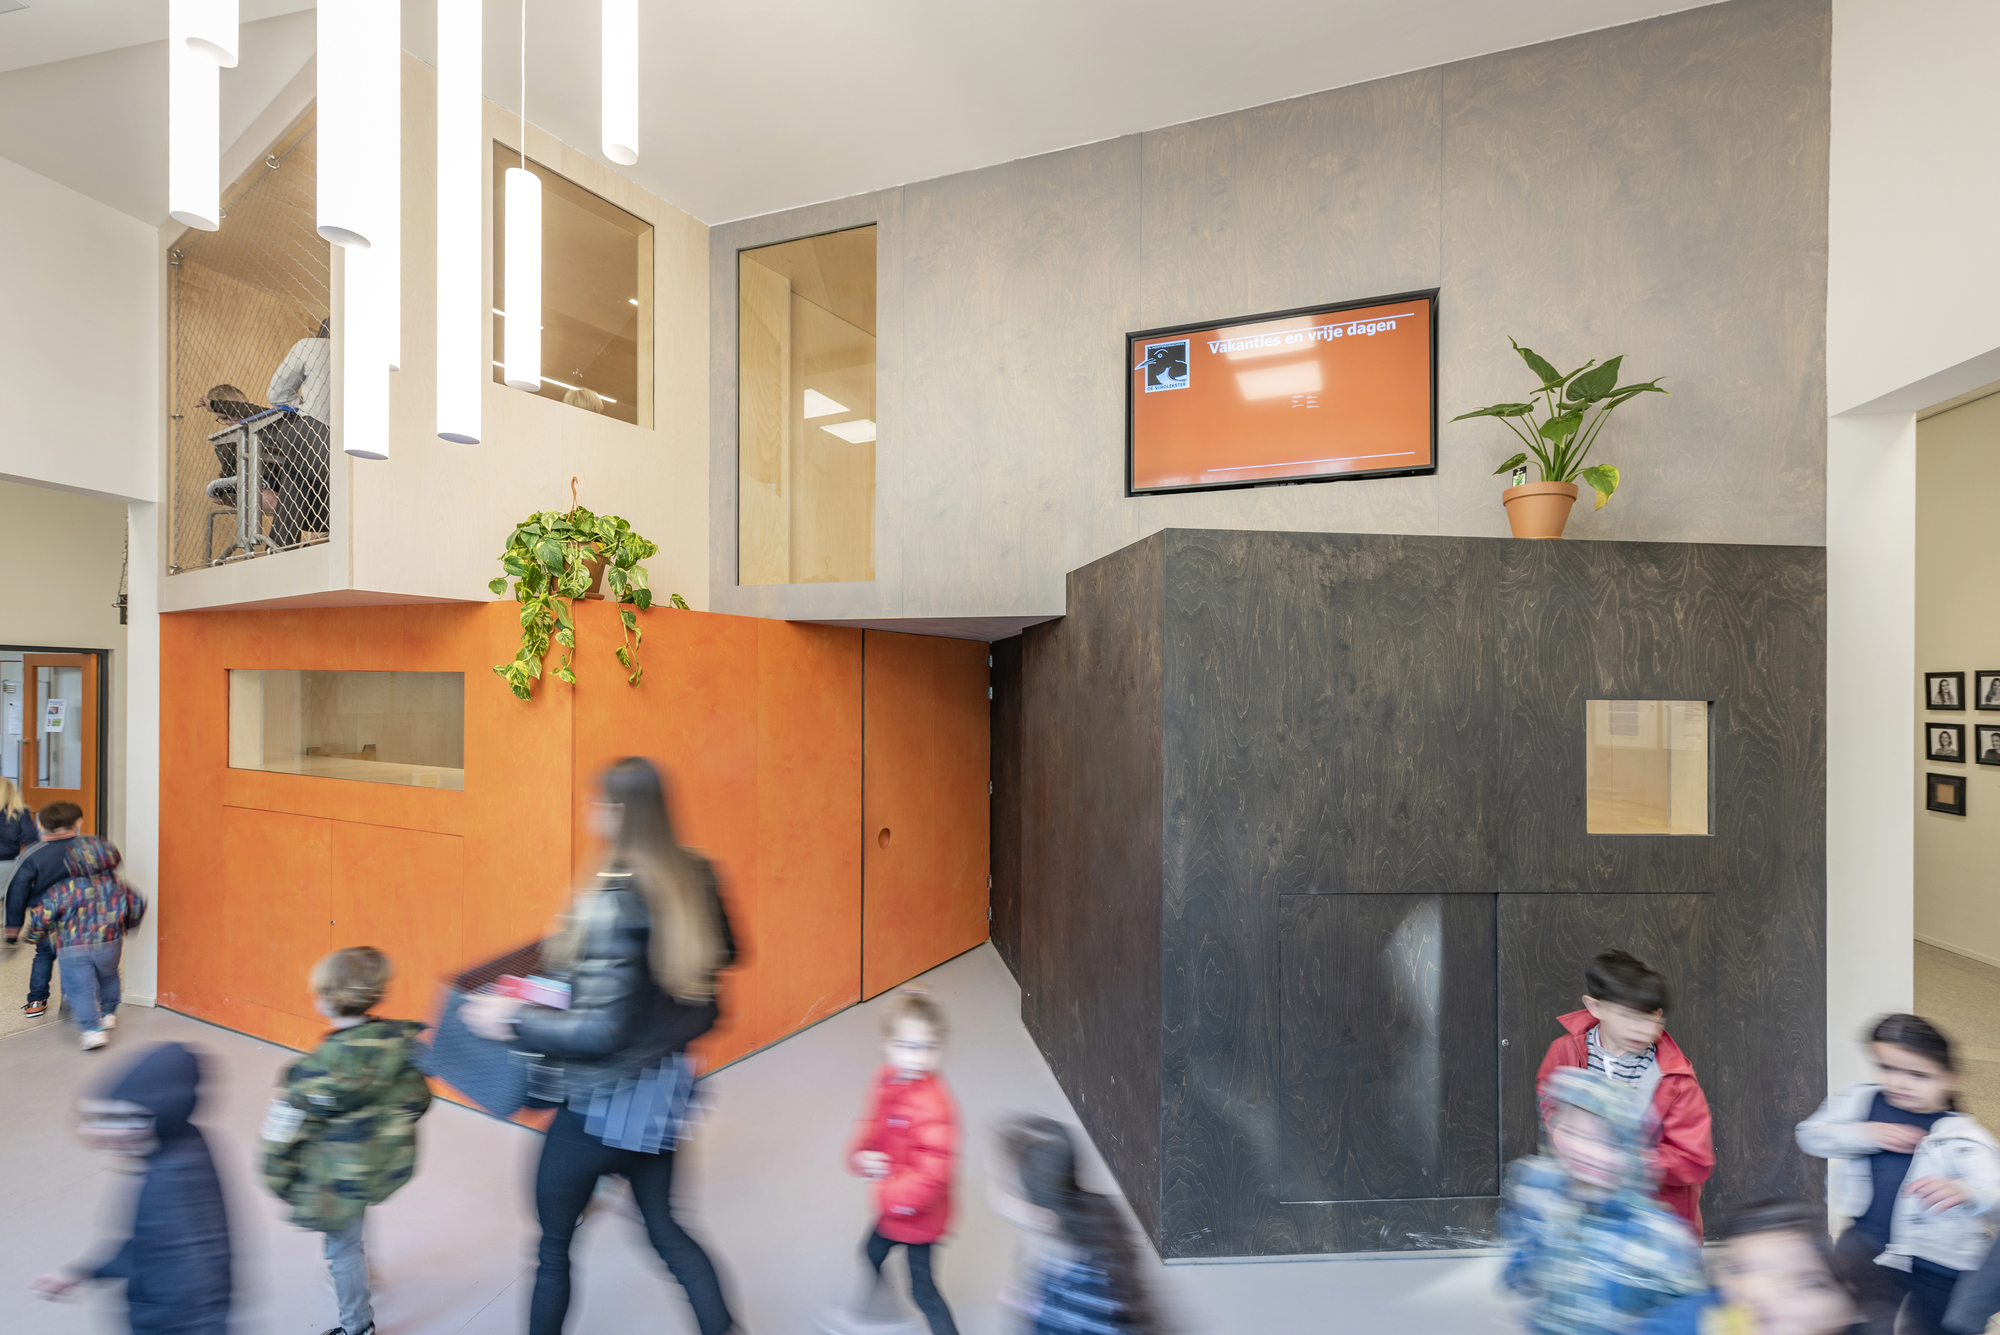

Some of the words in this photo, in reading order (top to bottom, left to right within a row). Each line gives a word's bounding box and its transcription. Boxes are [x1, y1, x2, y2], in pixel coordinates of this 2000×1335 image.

[1209, 335, 1281, 354] Vakanties
[1285, 332, 1304, 344] en
[1307, 326, 1344, 341] vrije
[1347, 320, 1396, 336] dagen
